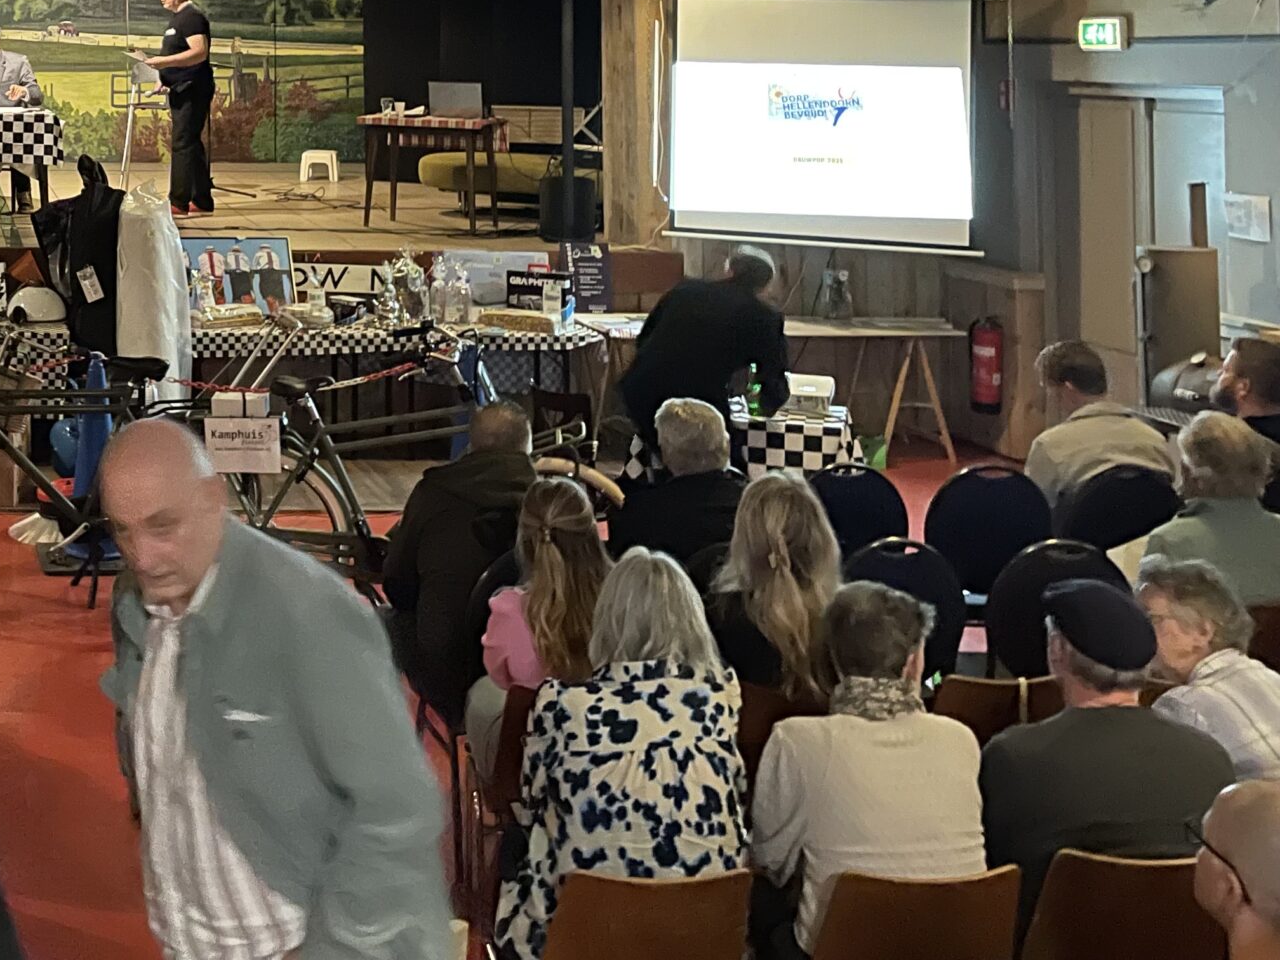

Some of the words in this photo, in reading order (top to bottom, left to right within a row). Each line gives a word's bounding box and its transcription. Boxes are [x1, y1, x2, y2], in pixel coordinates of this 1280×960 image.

[782, 95, 809, 103] DORP
[783, 97, 860, 111] HELLENDOORN
[210, 429, 264, 441] Kamphuis
